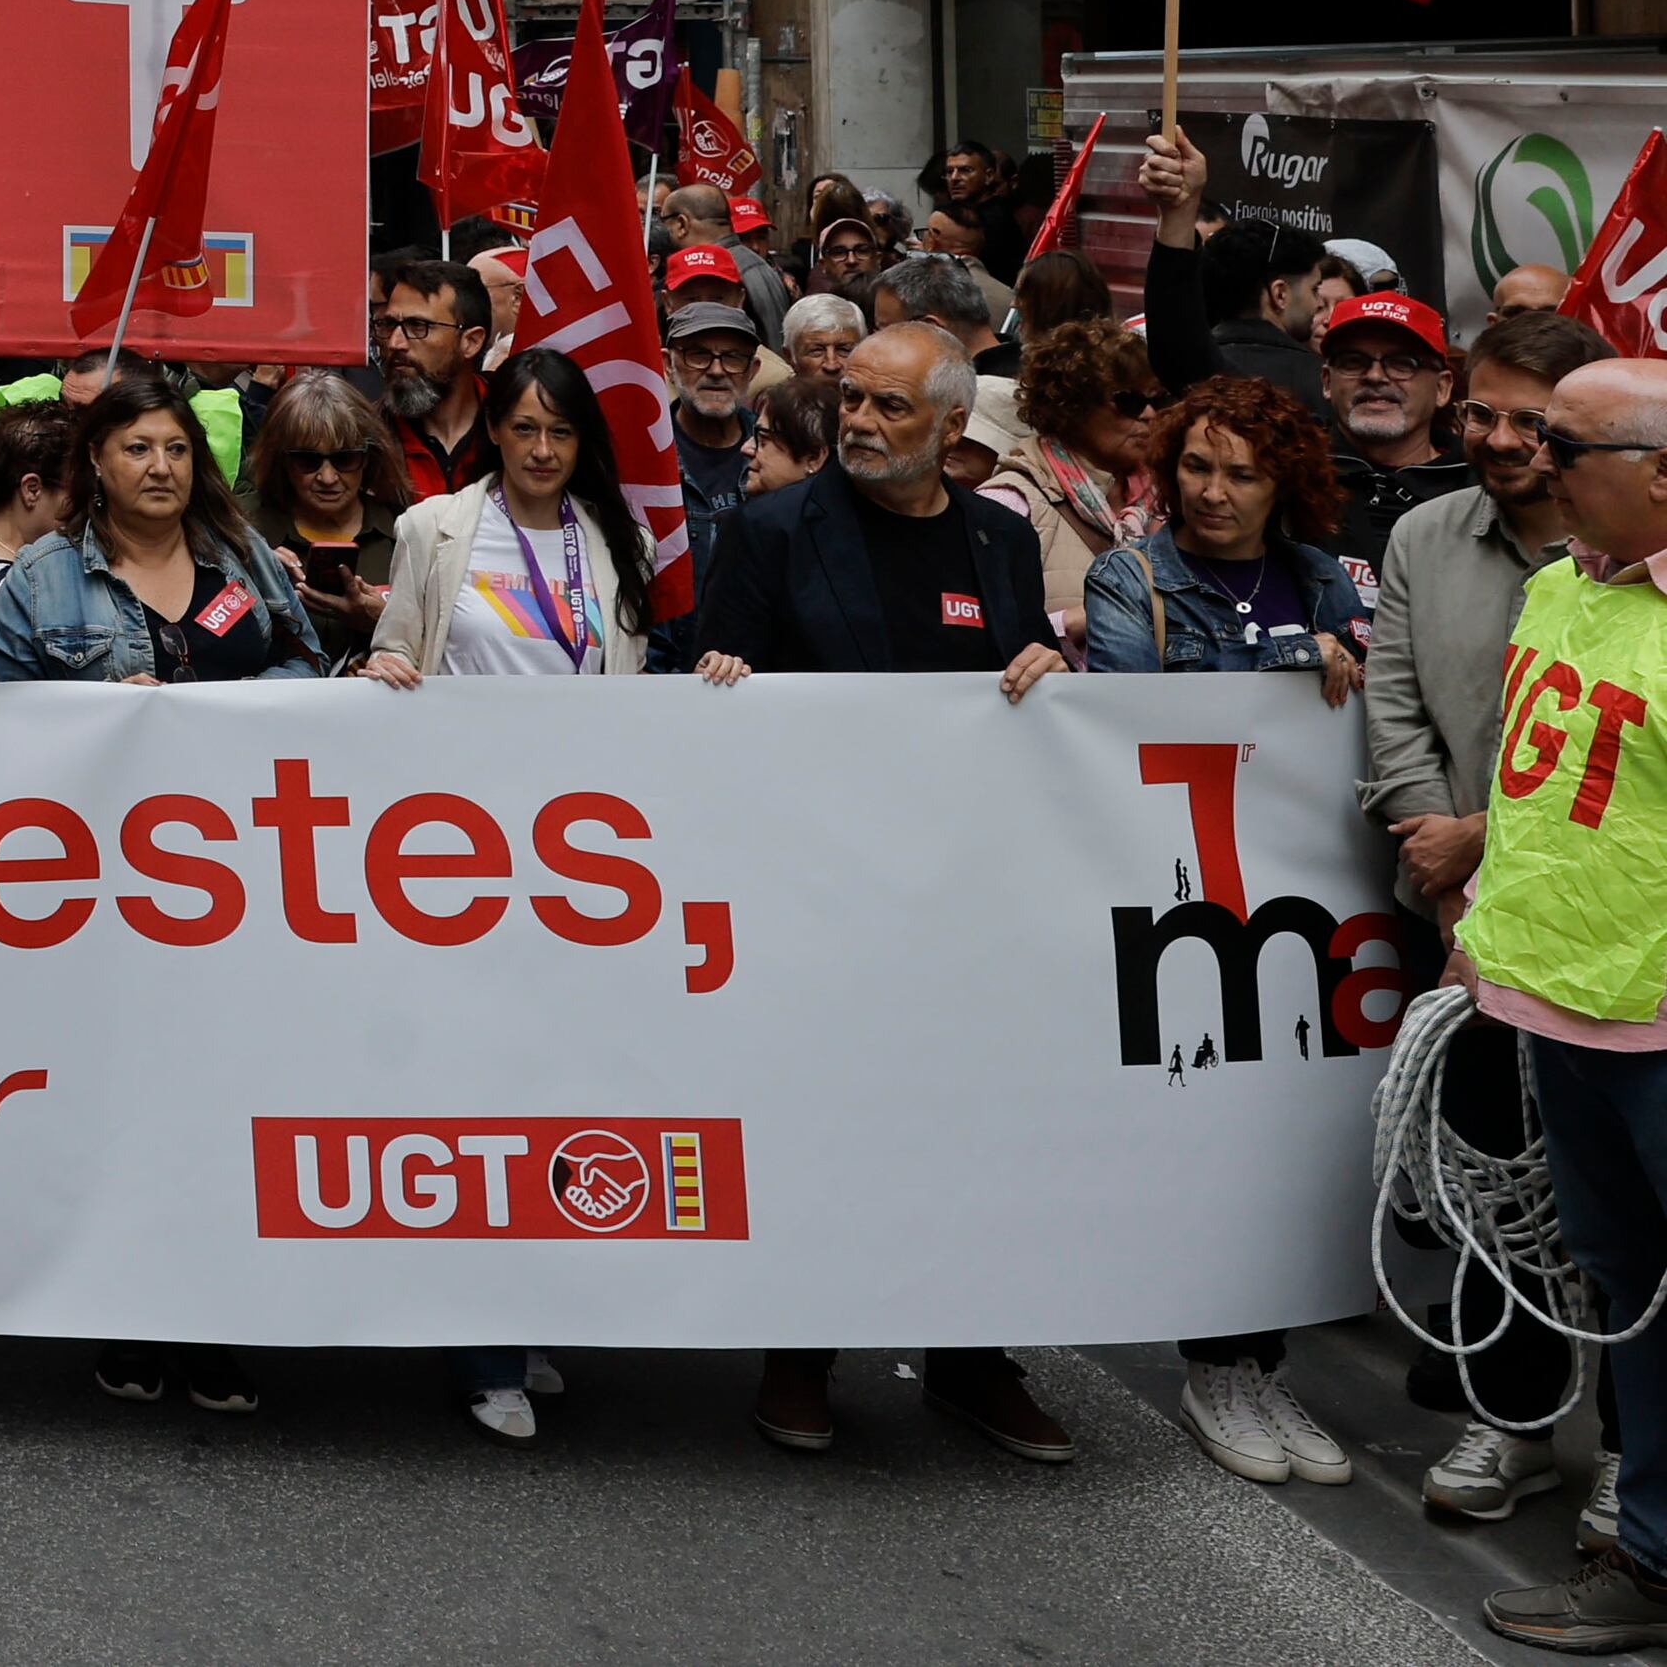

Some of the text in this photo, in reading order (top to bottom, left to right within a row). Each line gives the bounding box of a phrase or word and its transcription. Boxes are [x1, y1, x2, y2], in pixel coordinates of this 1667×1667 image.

[450, 72, 541, 147] UG
[1244, 131, 1329, 189] Rugar
[1280, 205, 1332, 234] positiva
[1362, 301, 1396, 311] UGT
[1382, 310, 1408, 322] FICA
[564, 523, 576, 547] UGT
[570, 588, 582, 613] UGT
[946, 600, 980, 621] UGT
[203, 603, 231, 630] UGT
[293, 1133, 529, 1229] UGT
